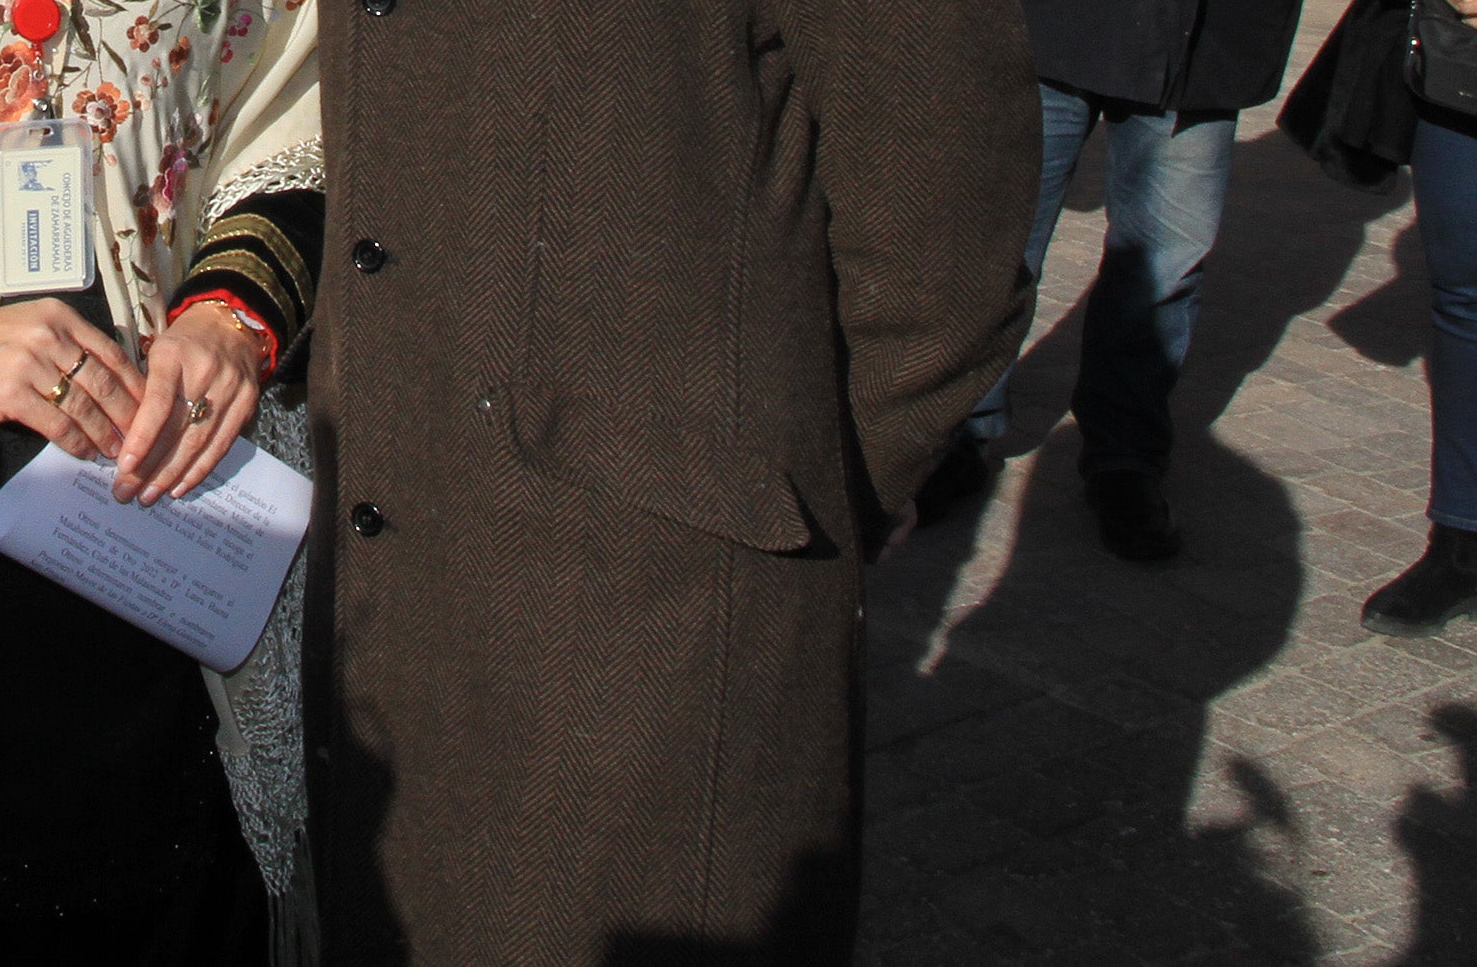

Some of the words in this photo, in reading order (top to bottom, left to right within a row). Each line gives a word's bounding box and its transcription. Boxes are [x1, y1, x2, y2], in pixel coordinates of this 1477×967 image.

[51, 195, 60, 206] DE
[62, 173, 72, 208] CONCEJO
[63, 209, 72, 220] DE
[51, 209, 61, 273] ZAMARRAMALA
[63, 223, 73, 272] AGUEDERAS
